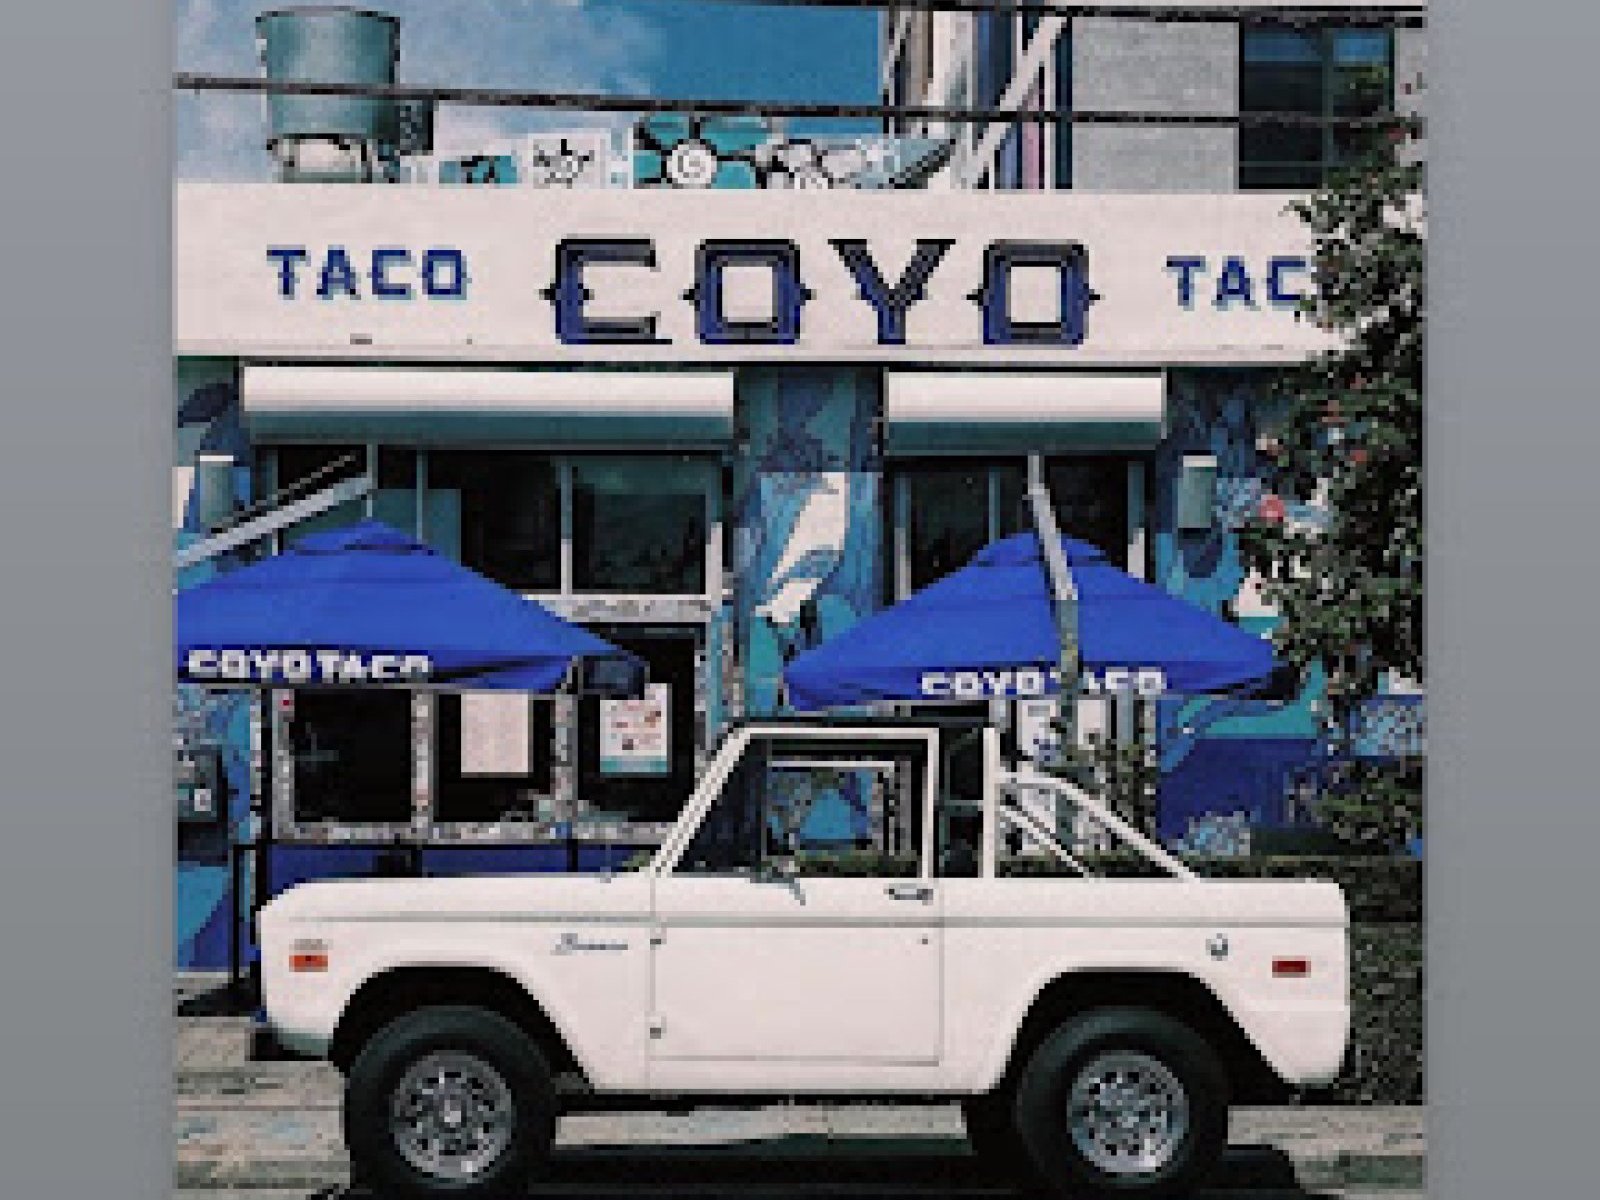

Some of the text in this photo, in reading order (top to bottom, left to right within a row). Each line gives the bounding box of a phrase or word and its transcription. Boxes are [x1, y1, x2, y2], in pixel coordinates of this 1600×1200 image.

[266, 237, 1307, 345] TACO COYO TAC
